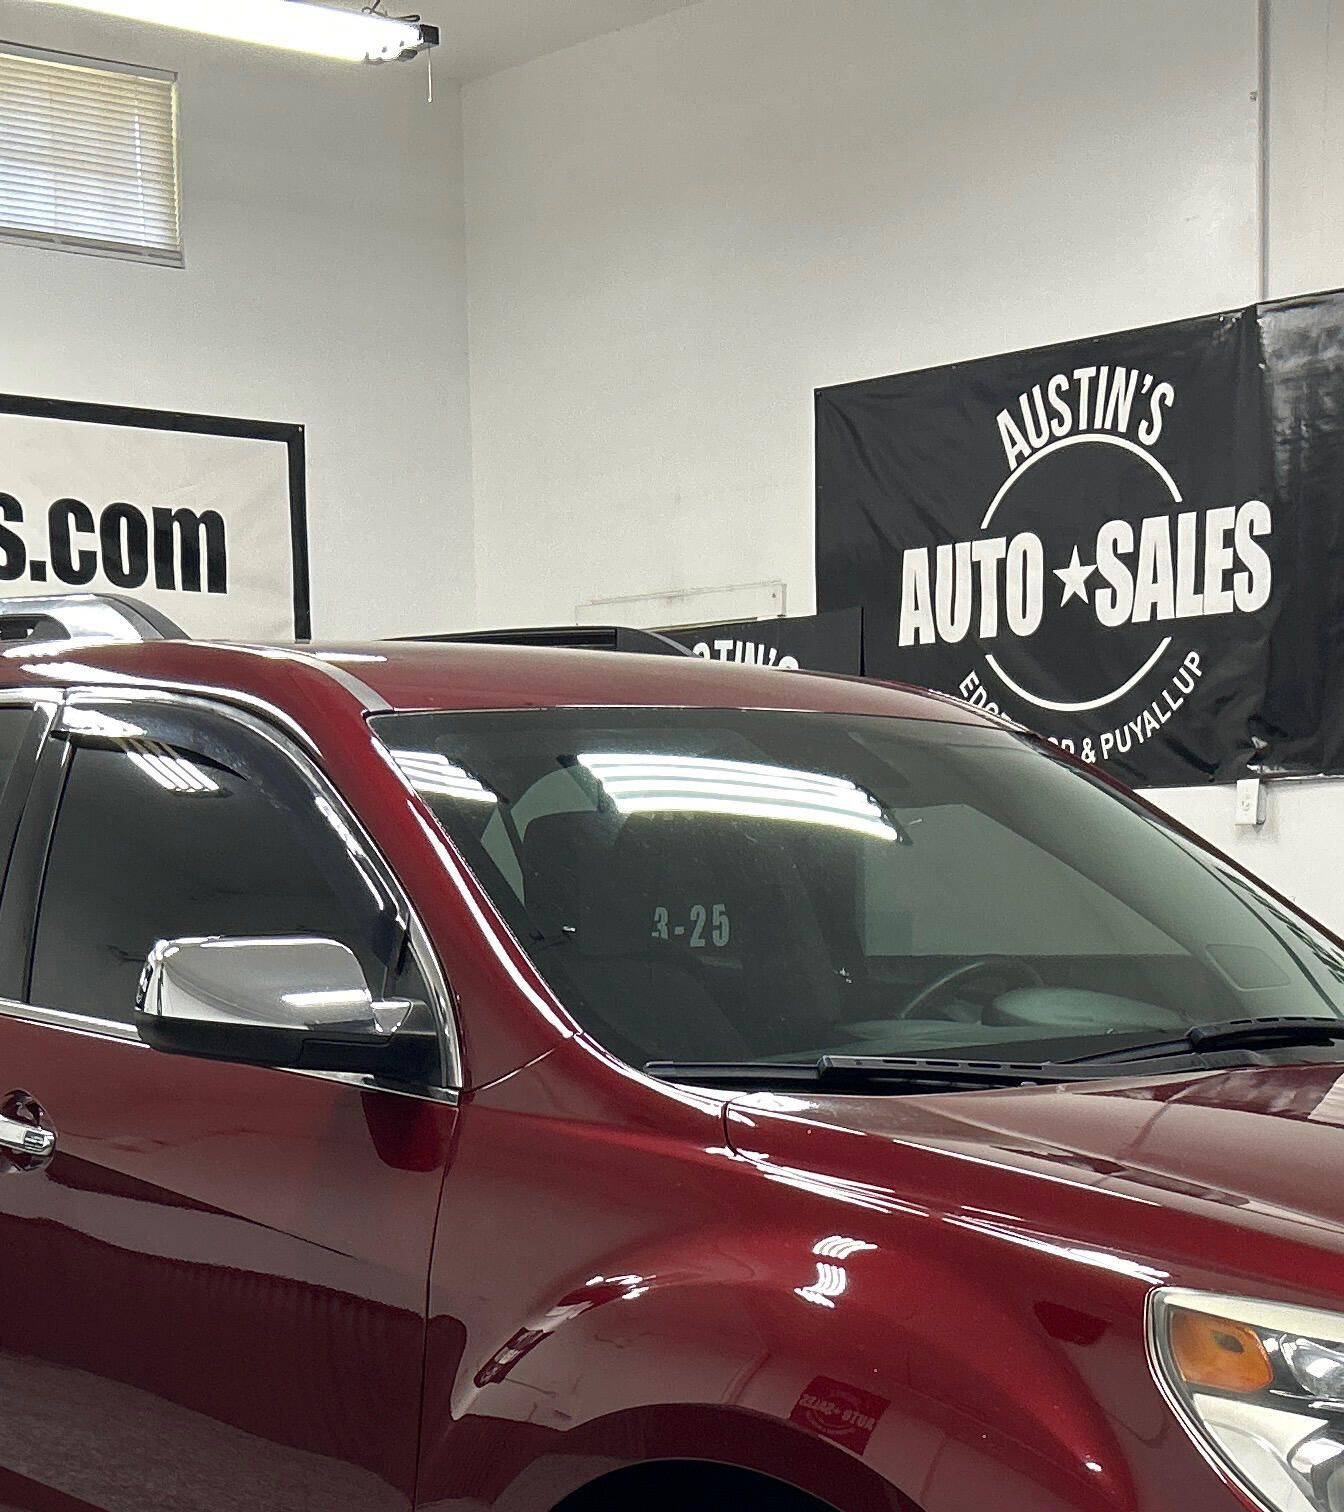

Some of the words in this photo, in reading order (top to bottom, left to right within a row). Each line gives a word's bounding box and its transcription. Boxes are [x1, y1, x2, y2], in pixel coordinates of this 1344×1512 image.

[994, 363, 1175, 470] AUSTIN'S
[898, 531, 1044, 647] AUTO
[1095, 500, 1272, 628] SALES
[1080, 737, 1096, 764] &
[1100, 651, 1203, 760] PUYALLUP
